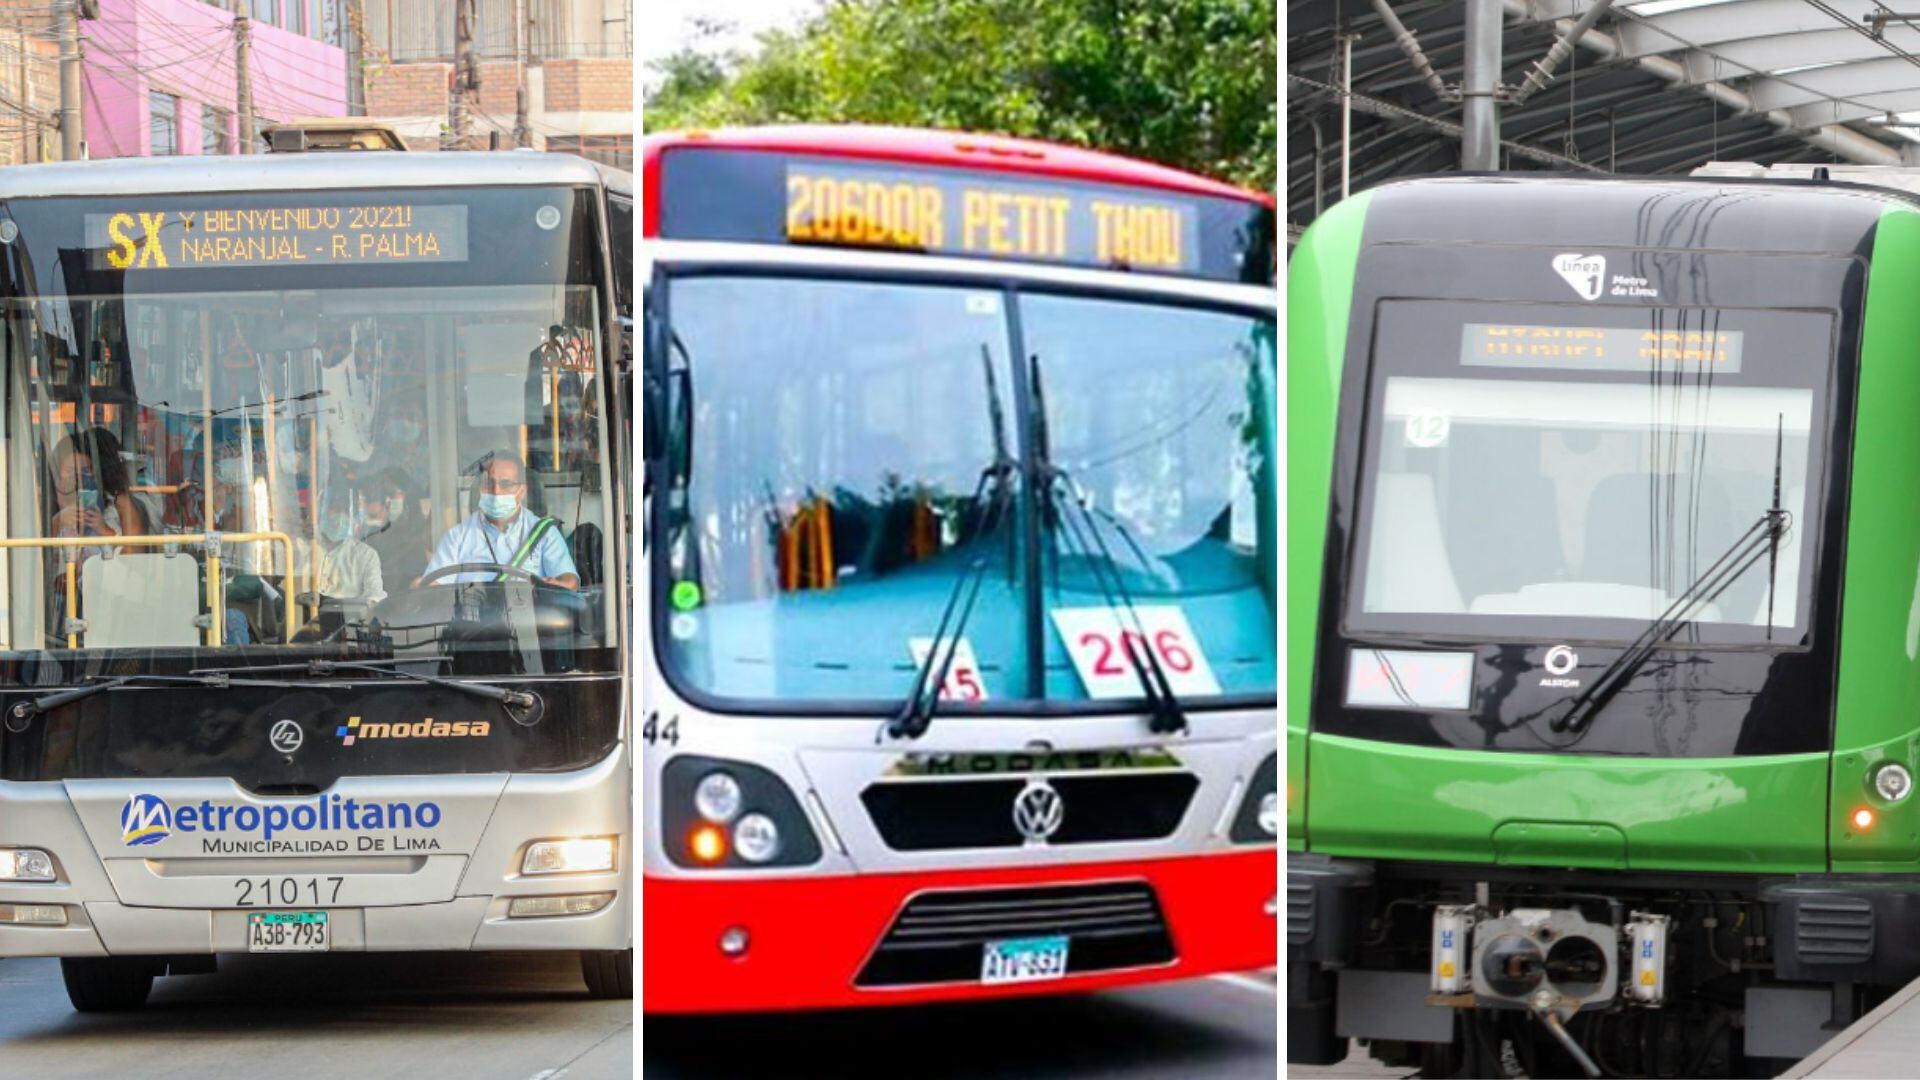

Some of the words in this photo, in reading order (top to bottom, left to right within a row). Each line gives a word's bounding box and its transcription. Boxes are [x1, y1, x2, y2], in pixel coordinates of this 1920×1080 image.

[179, 210, 196, 232] Y
[204, 207, 341, 233] BIENVENIDO
[348, 205, 412, 229] 2021!
[962, 188, 1070, 257] PETIT
[1091, 200, 1182, 265] THOU
[106, 211, 169, 269] SX
[181, 234, 306, 263] NARANJAL
[331, 233, 352, 260] R.
[359, 231, 441, 259] PALMA
[1587, 274, 1599, 296] 1
[1611, 285, 1628, 296] de
[1629, 286, 1658, 298] Lima
[1612, 275, 1648, 287] Metro
[1411, 415, 1443, 440] 12
[358, 717, 491, 739] modasa
[121, 792, 442, 846] Metropolitano
[234, 876, 344, 907] 21017
[253, 921, 325, 946] A3B-793
